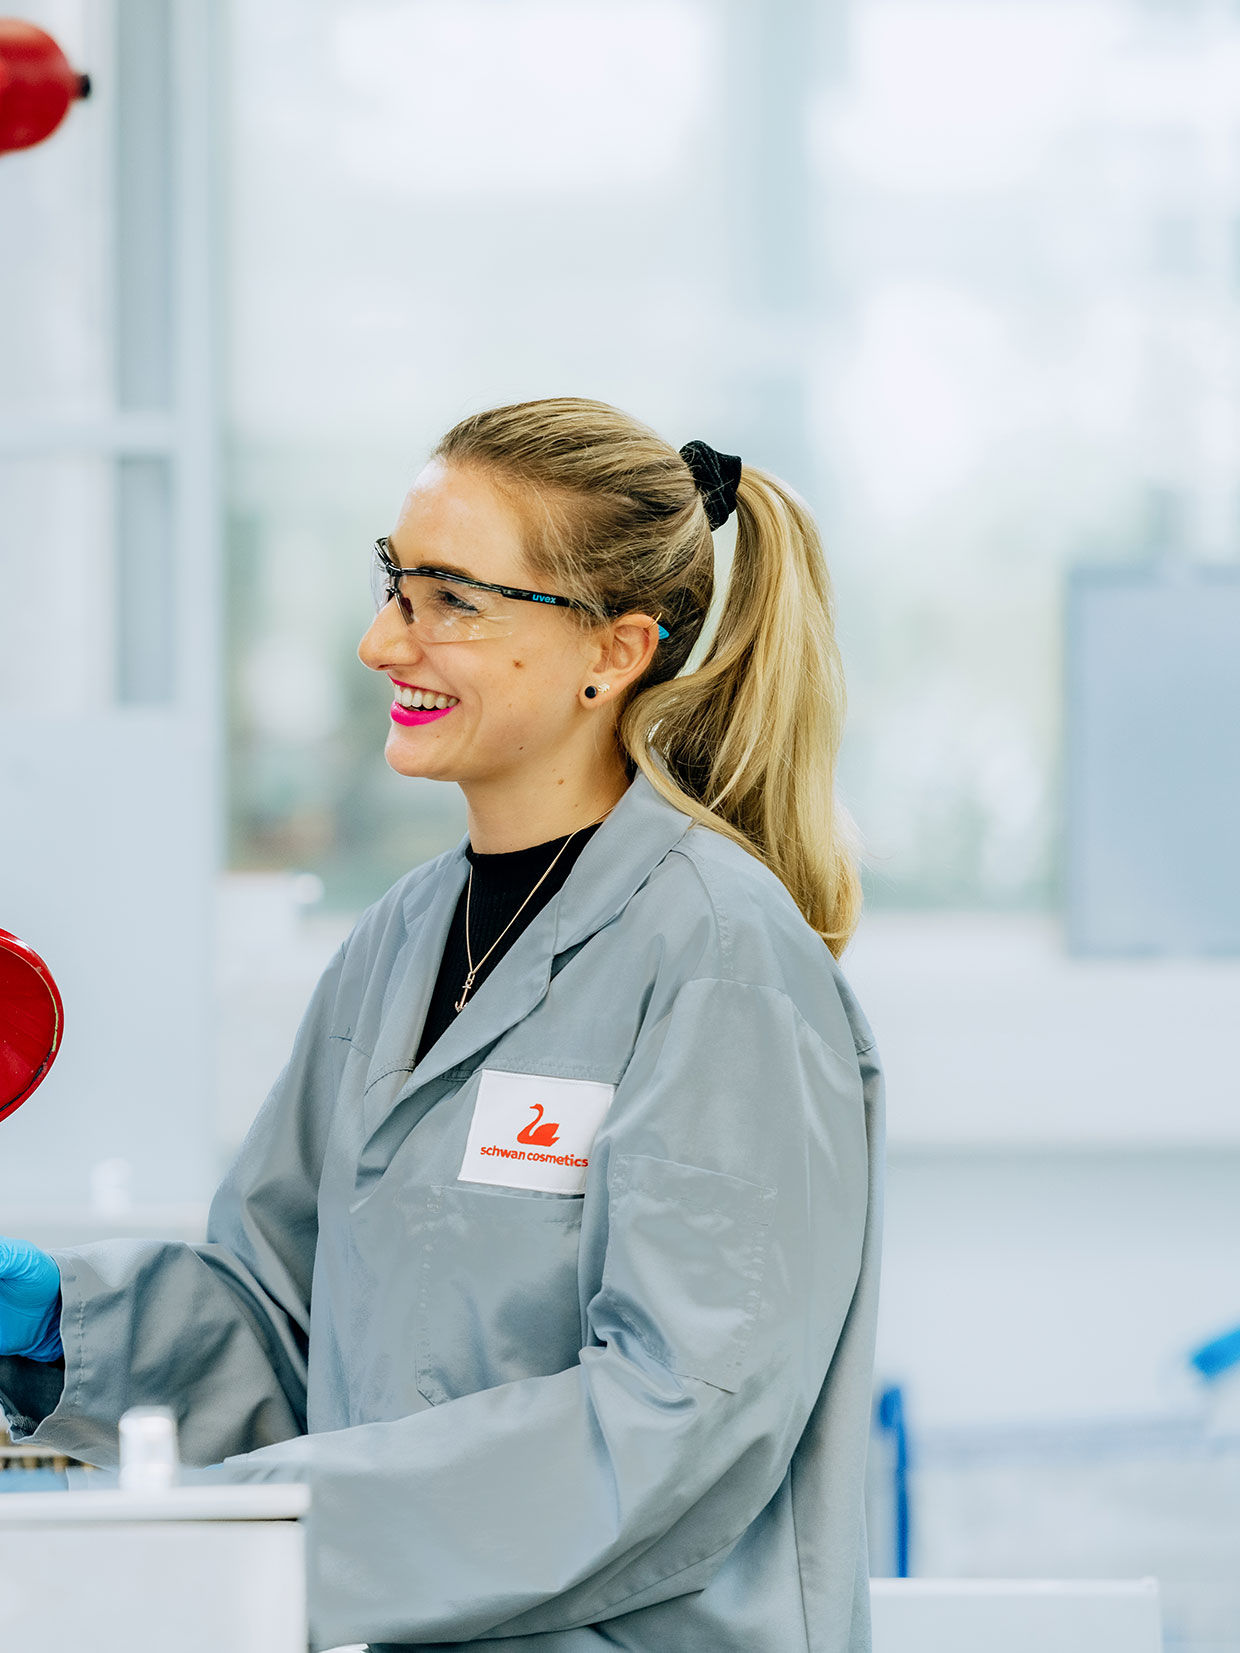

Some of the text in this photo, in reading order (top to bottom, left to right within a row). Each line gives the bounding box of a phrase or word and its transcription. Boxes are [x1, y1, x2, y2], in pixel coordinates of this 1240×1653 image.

[532, 593, 557, 604] uvex
[480, 1145, 589, 1168] schwan cosmetics
